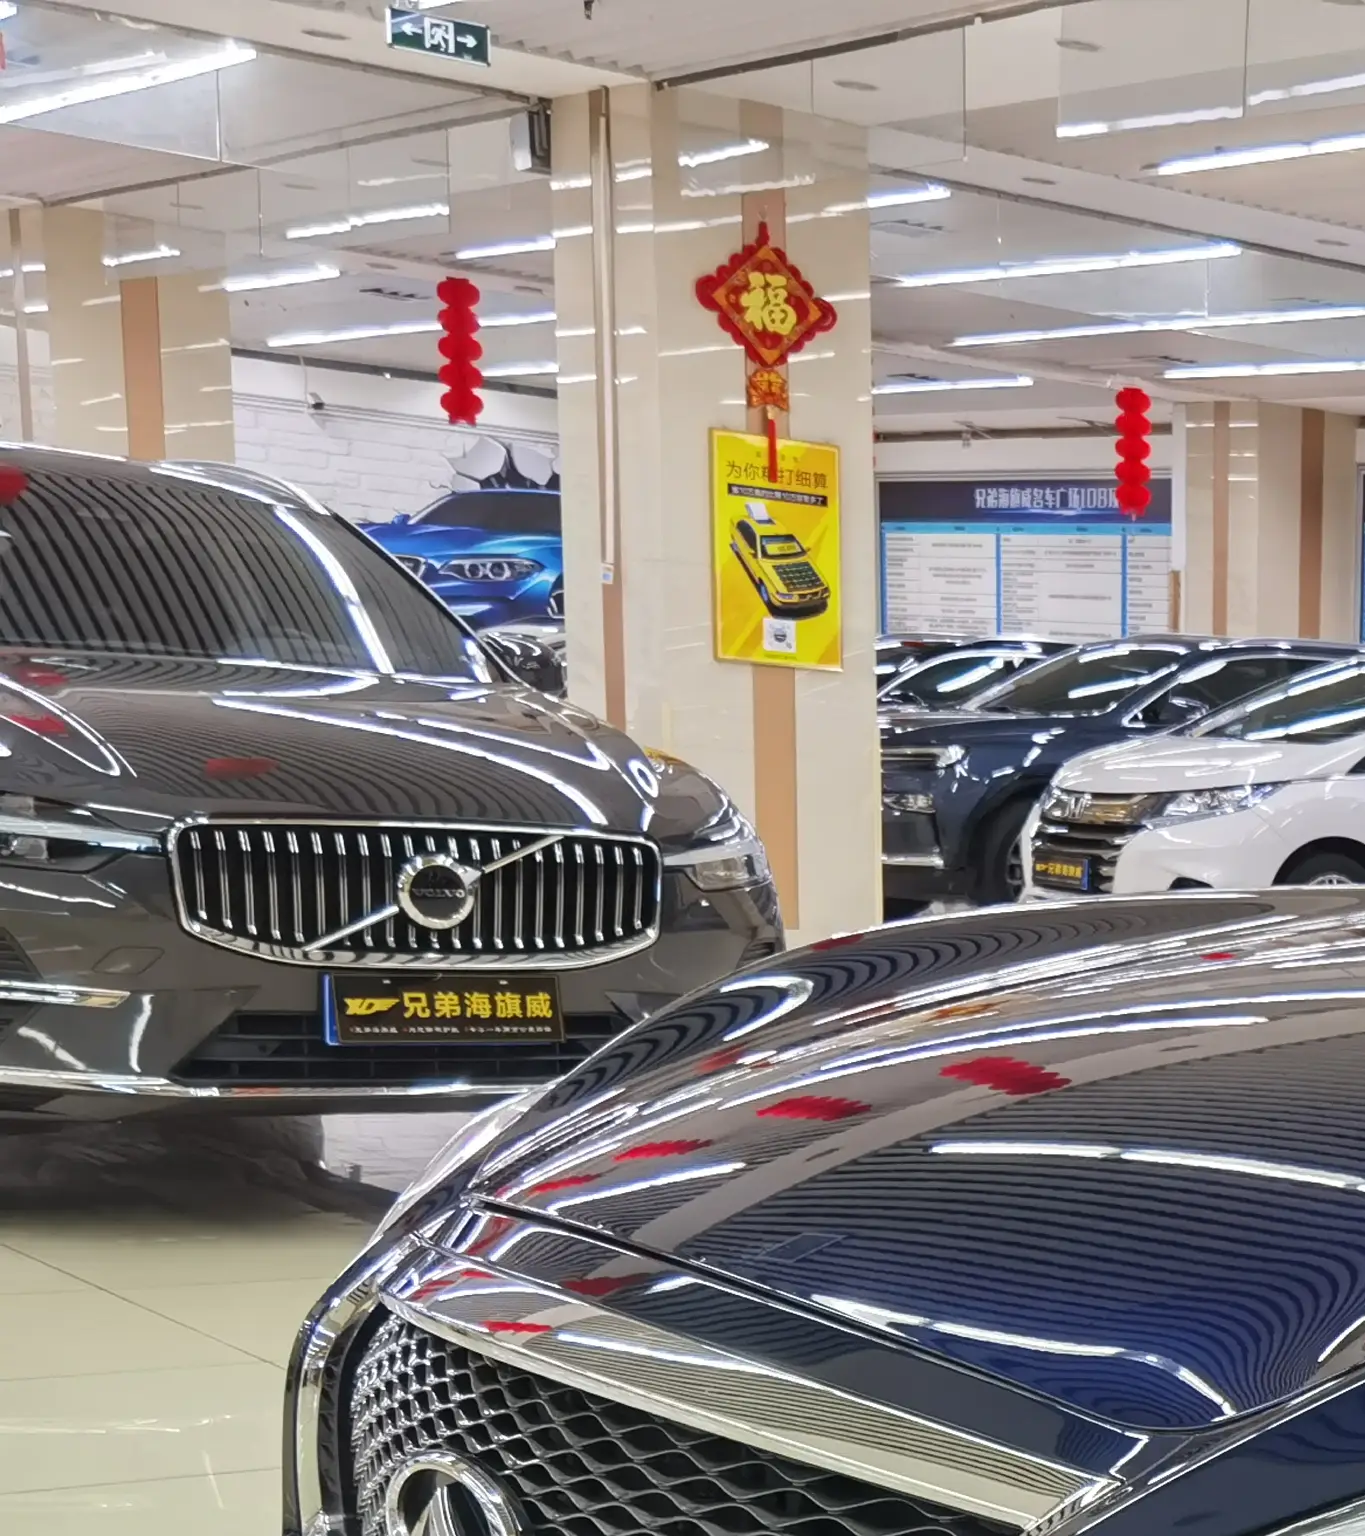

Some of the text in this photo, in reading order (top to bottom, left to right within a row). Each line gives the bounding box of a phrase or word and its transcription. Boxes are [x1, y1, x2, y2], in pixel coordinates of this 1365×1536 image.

[740, 271, 797, 335] 福
[412, 888, 466, 898] VOLVO
[402, 991, 553, 1019] 兄弟海旗威
